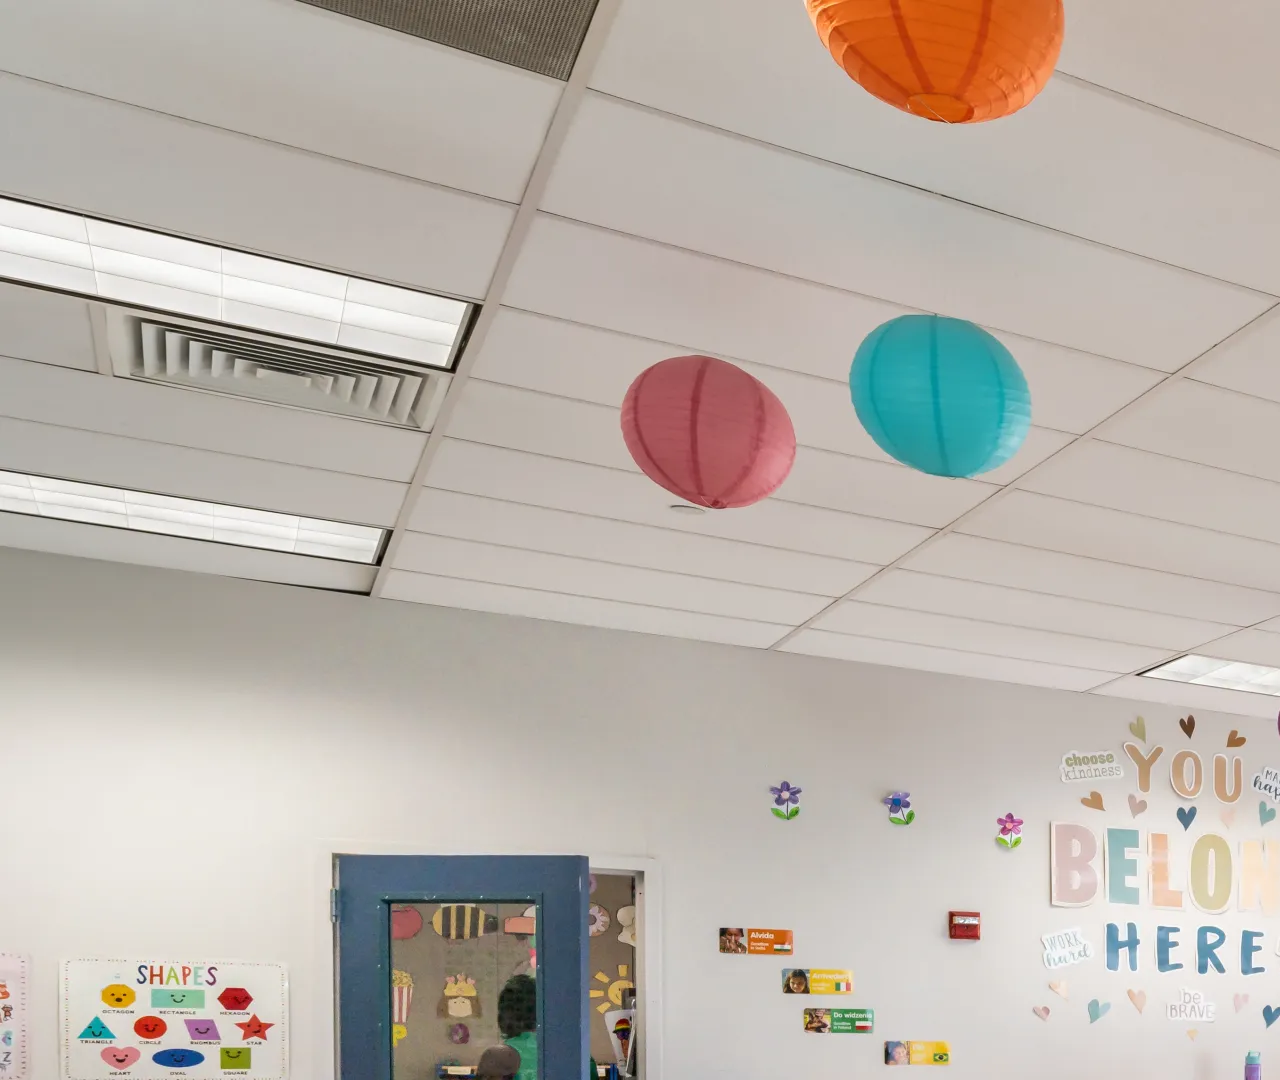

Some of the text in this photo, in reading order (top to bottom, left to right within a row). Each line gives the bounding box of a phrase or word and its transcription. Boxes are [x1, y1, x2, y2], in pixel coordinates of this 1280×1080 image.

[1065, 752, 1114, 767] choose
[1063, 765, 1122, 781] kindness
[1125, 744, 1243, 803] YOU
[750, 931, 775, 940] Alvida
[1046, 931, 1083, 951] WORK
[1047, 943, 1092, 967] hard
[1105, 922, 1266, 975] HERE
[136, 964, 218, 986] SHAPES
[1182, 989, 1201, 1005] be
[1169, 1004, 1214, 1020] BRAVE
